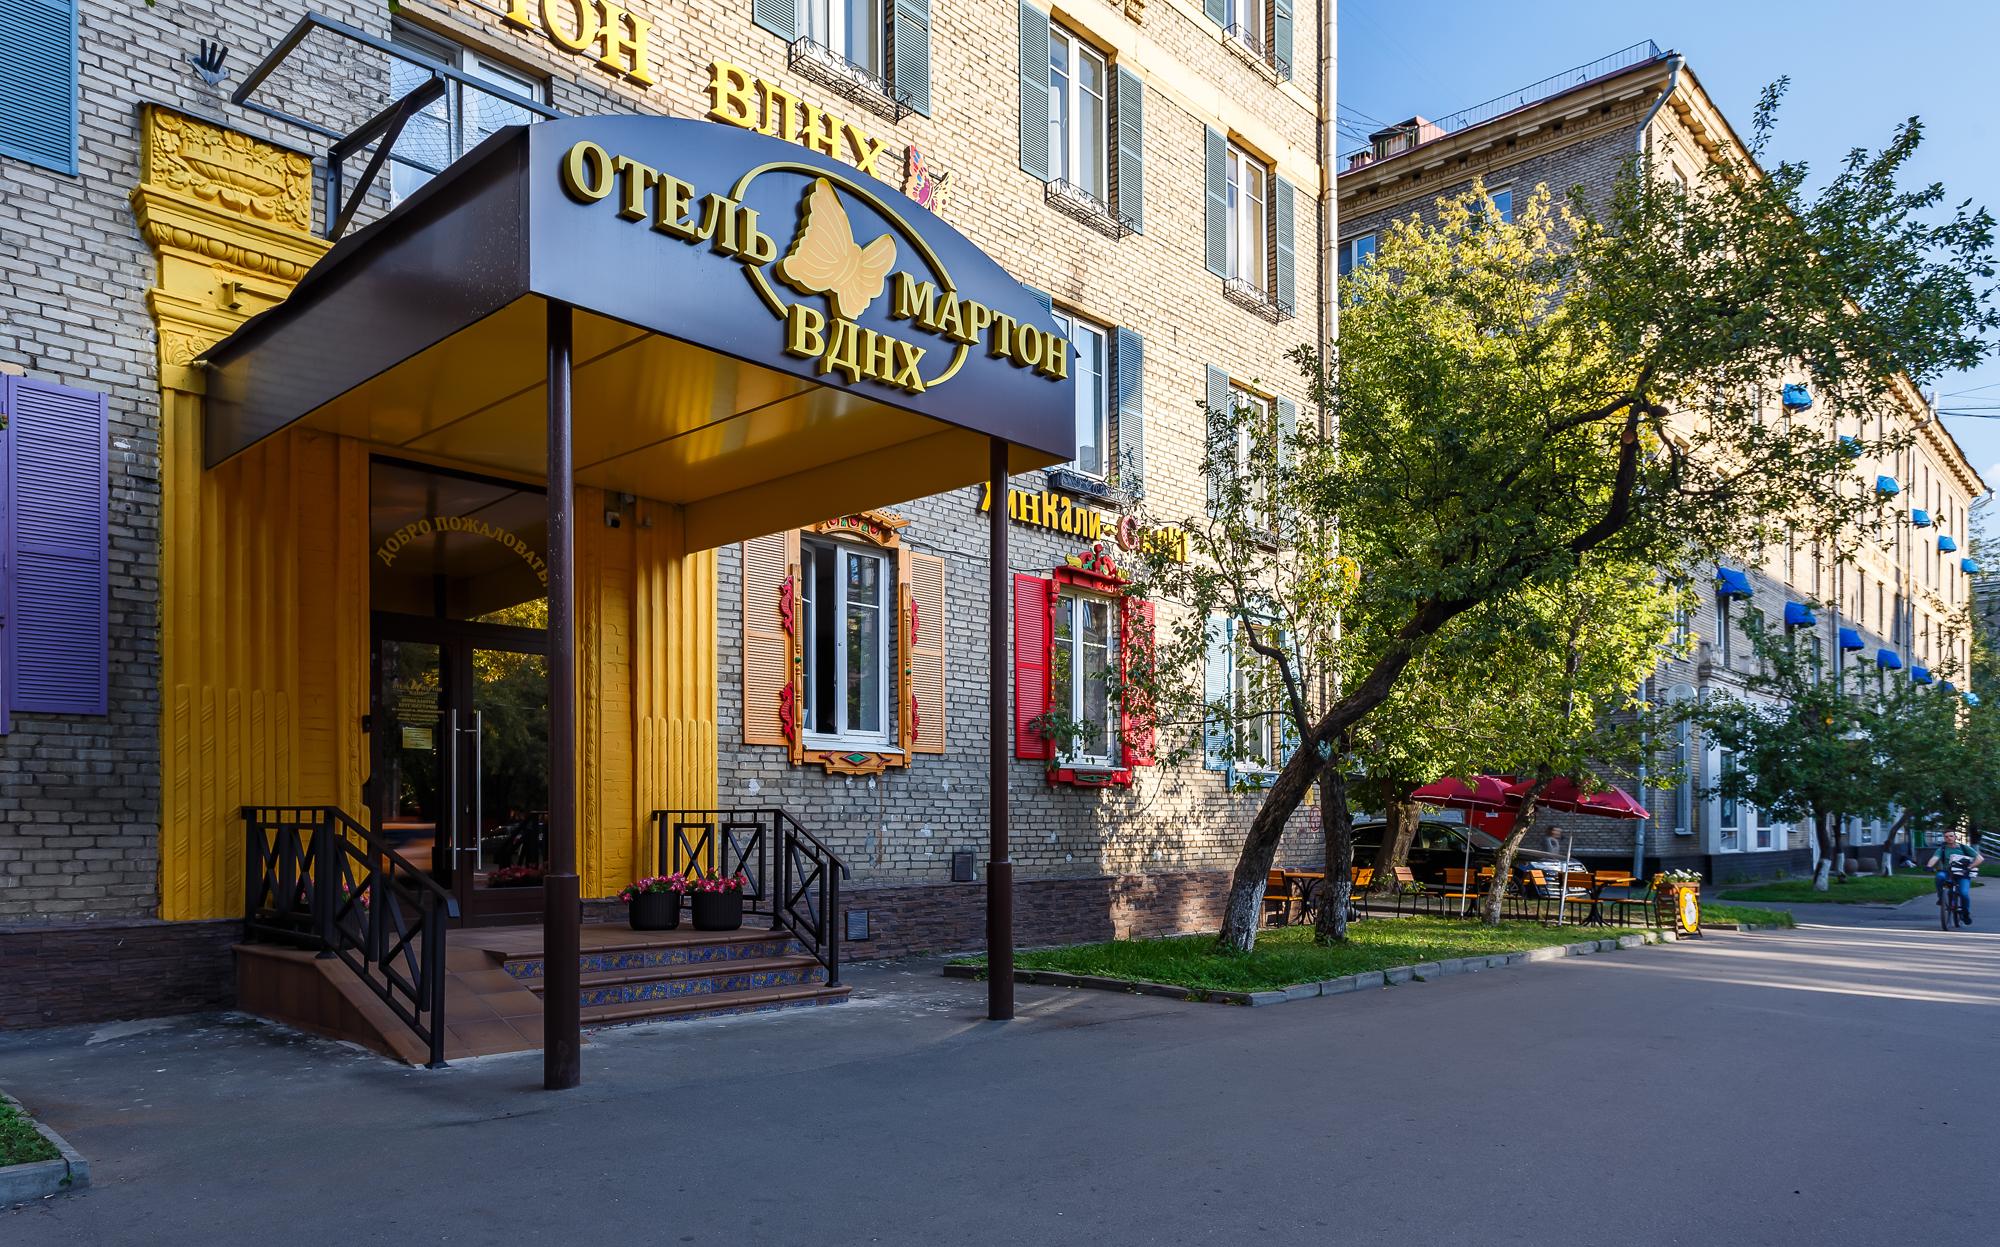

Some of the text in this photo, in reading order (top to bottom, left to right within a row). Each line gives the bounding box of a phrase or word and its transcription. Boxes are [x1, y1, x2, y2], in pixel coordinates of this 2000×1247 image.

[563, 140, 1069, 380] ОТЕЛЬ МАРТОН
[787, 303, 927, 394] ВДНХ
[376, 519, 431, 567] ДОБРО
